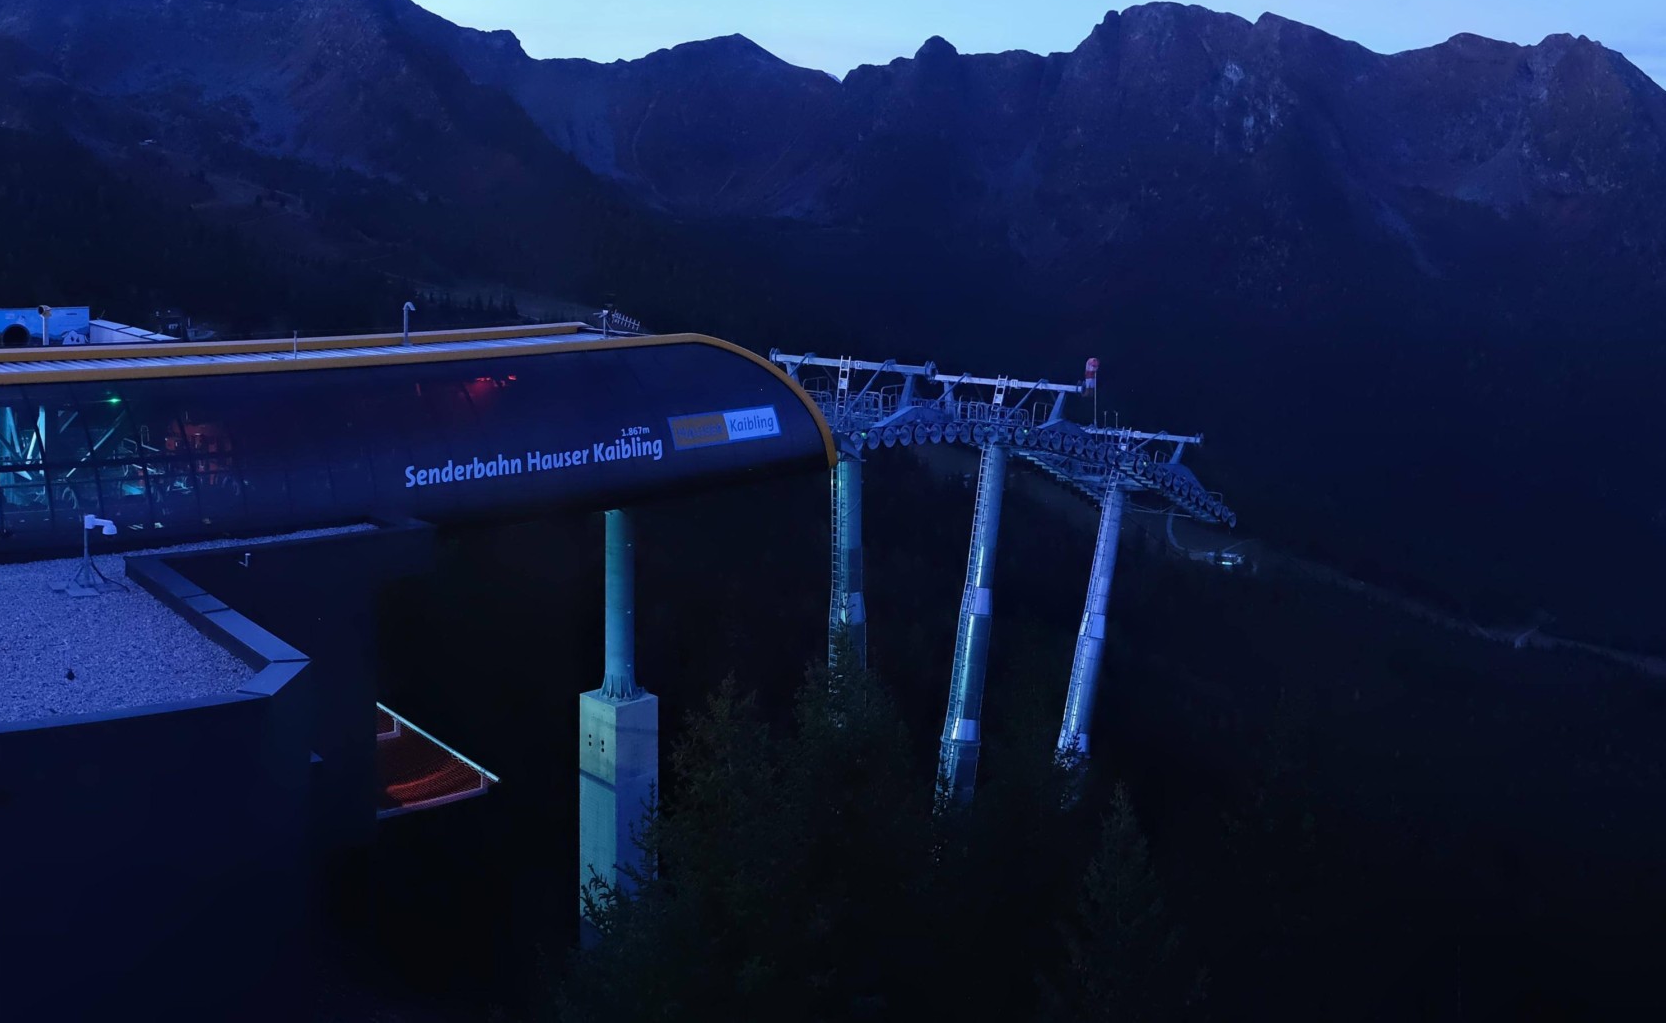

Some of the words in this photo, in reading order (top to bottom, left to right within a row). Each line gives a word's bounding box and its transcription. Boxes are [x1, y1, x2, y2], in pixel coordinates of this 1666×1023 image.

[621, 426, 650, 437] 1.867m
[729, 415, 774, 433] Kaibling
[404, 458, 522, 488] Senderbahn
[526, 449, 590, 472] Hauser
[593, 437, 663, 462] Kaibling
